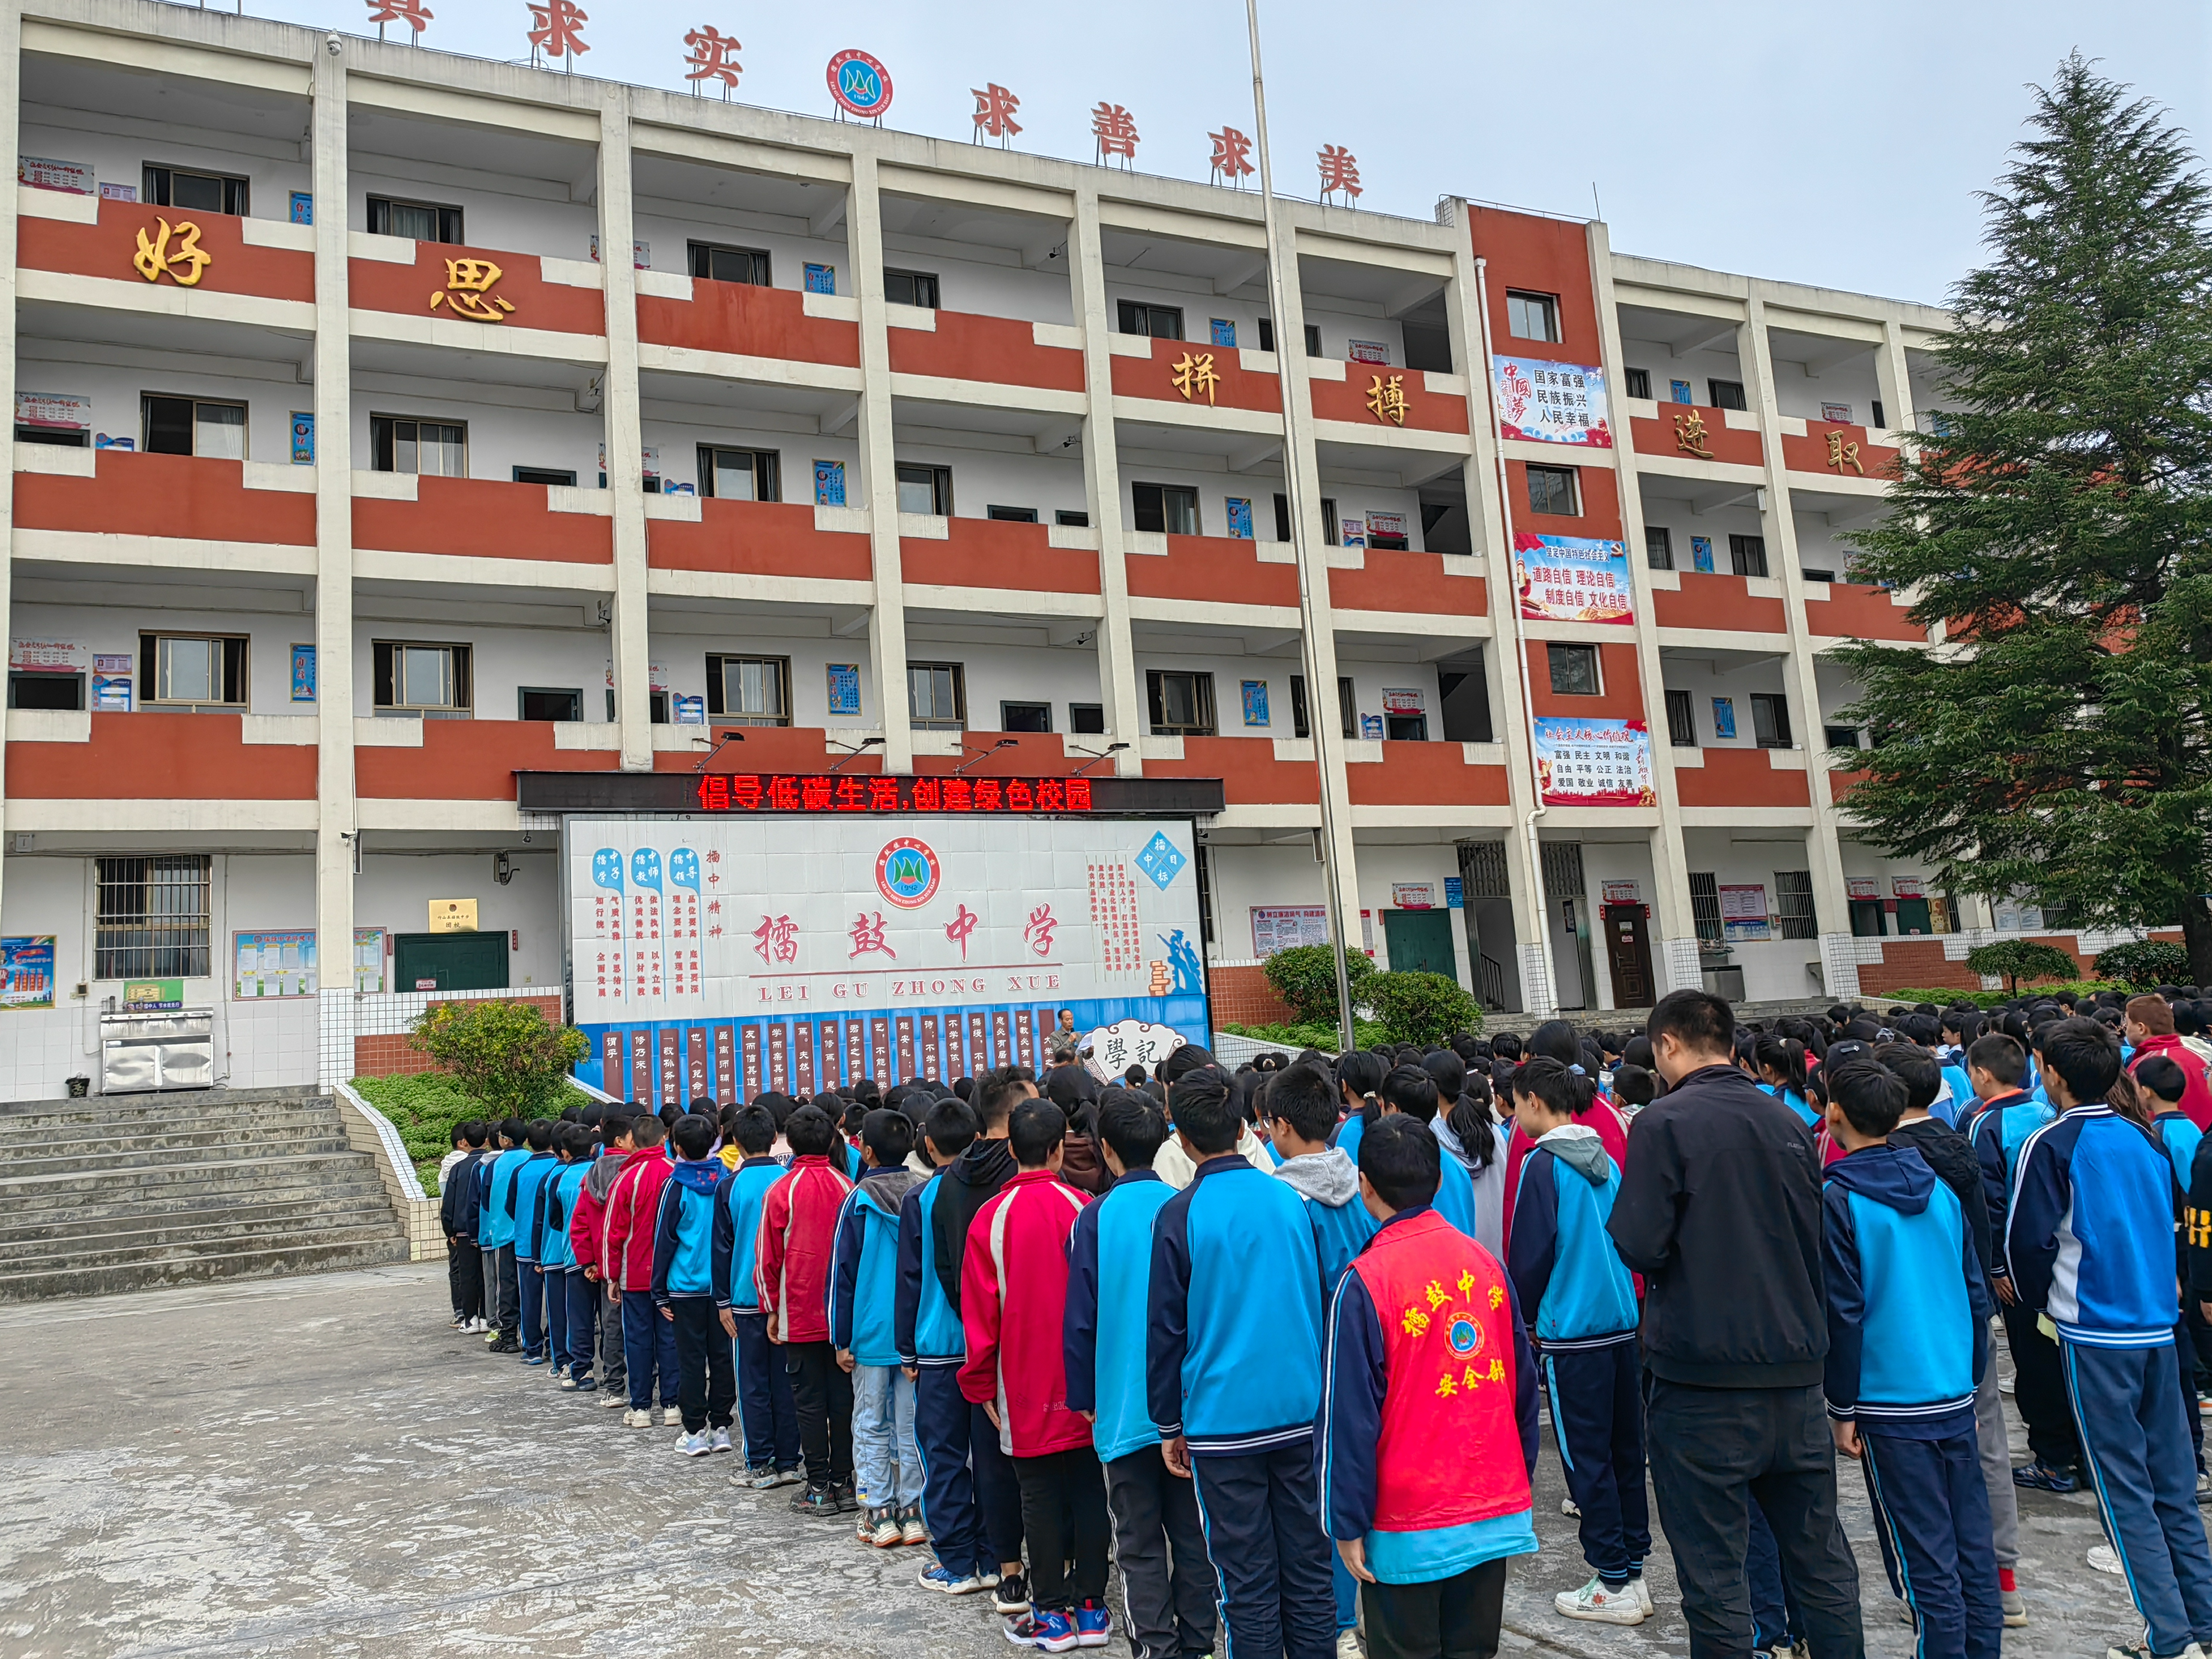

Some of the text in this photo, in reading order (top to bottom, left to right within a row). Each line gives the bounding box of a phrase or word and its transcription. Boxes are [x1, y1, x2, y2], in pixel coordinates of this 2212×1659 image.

[133, 215, 212, 286] 好
[430, 257, 516, 323] 思
[1171, 351, 1411, 427] 拼 搏
[1534, 369, 1585, 390] 国家富强
[1537, 388, 1587, 408] 民族振兴
[1539, 409, 1590, 427] 人民幸福
[1674, 409, 1864, 474] 进 取
[1532, 566, 1615, 589] 道路自信 理论自信
[1545, 588, 1627, 611] 制度自信 文化自信
[752, 902, 1059, 965] 擂鼓中学
[758, 974, 1060, 1002] LEI GU ZHONG XUE
[849, 1024, 862, 1088] 君子之于学
[1104, 1038, 1162, 1071] 學記
[1434, 1358, 1506, 1399] 安全部
